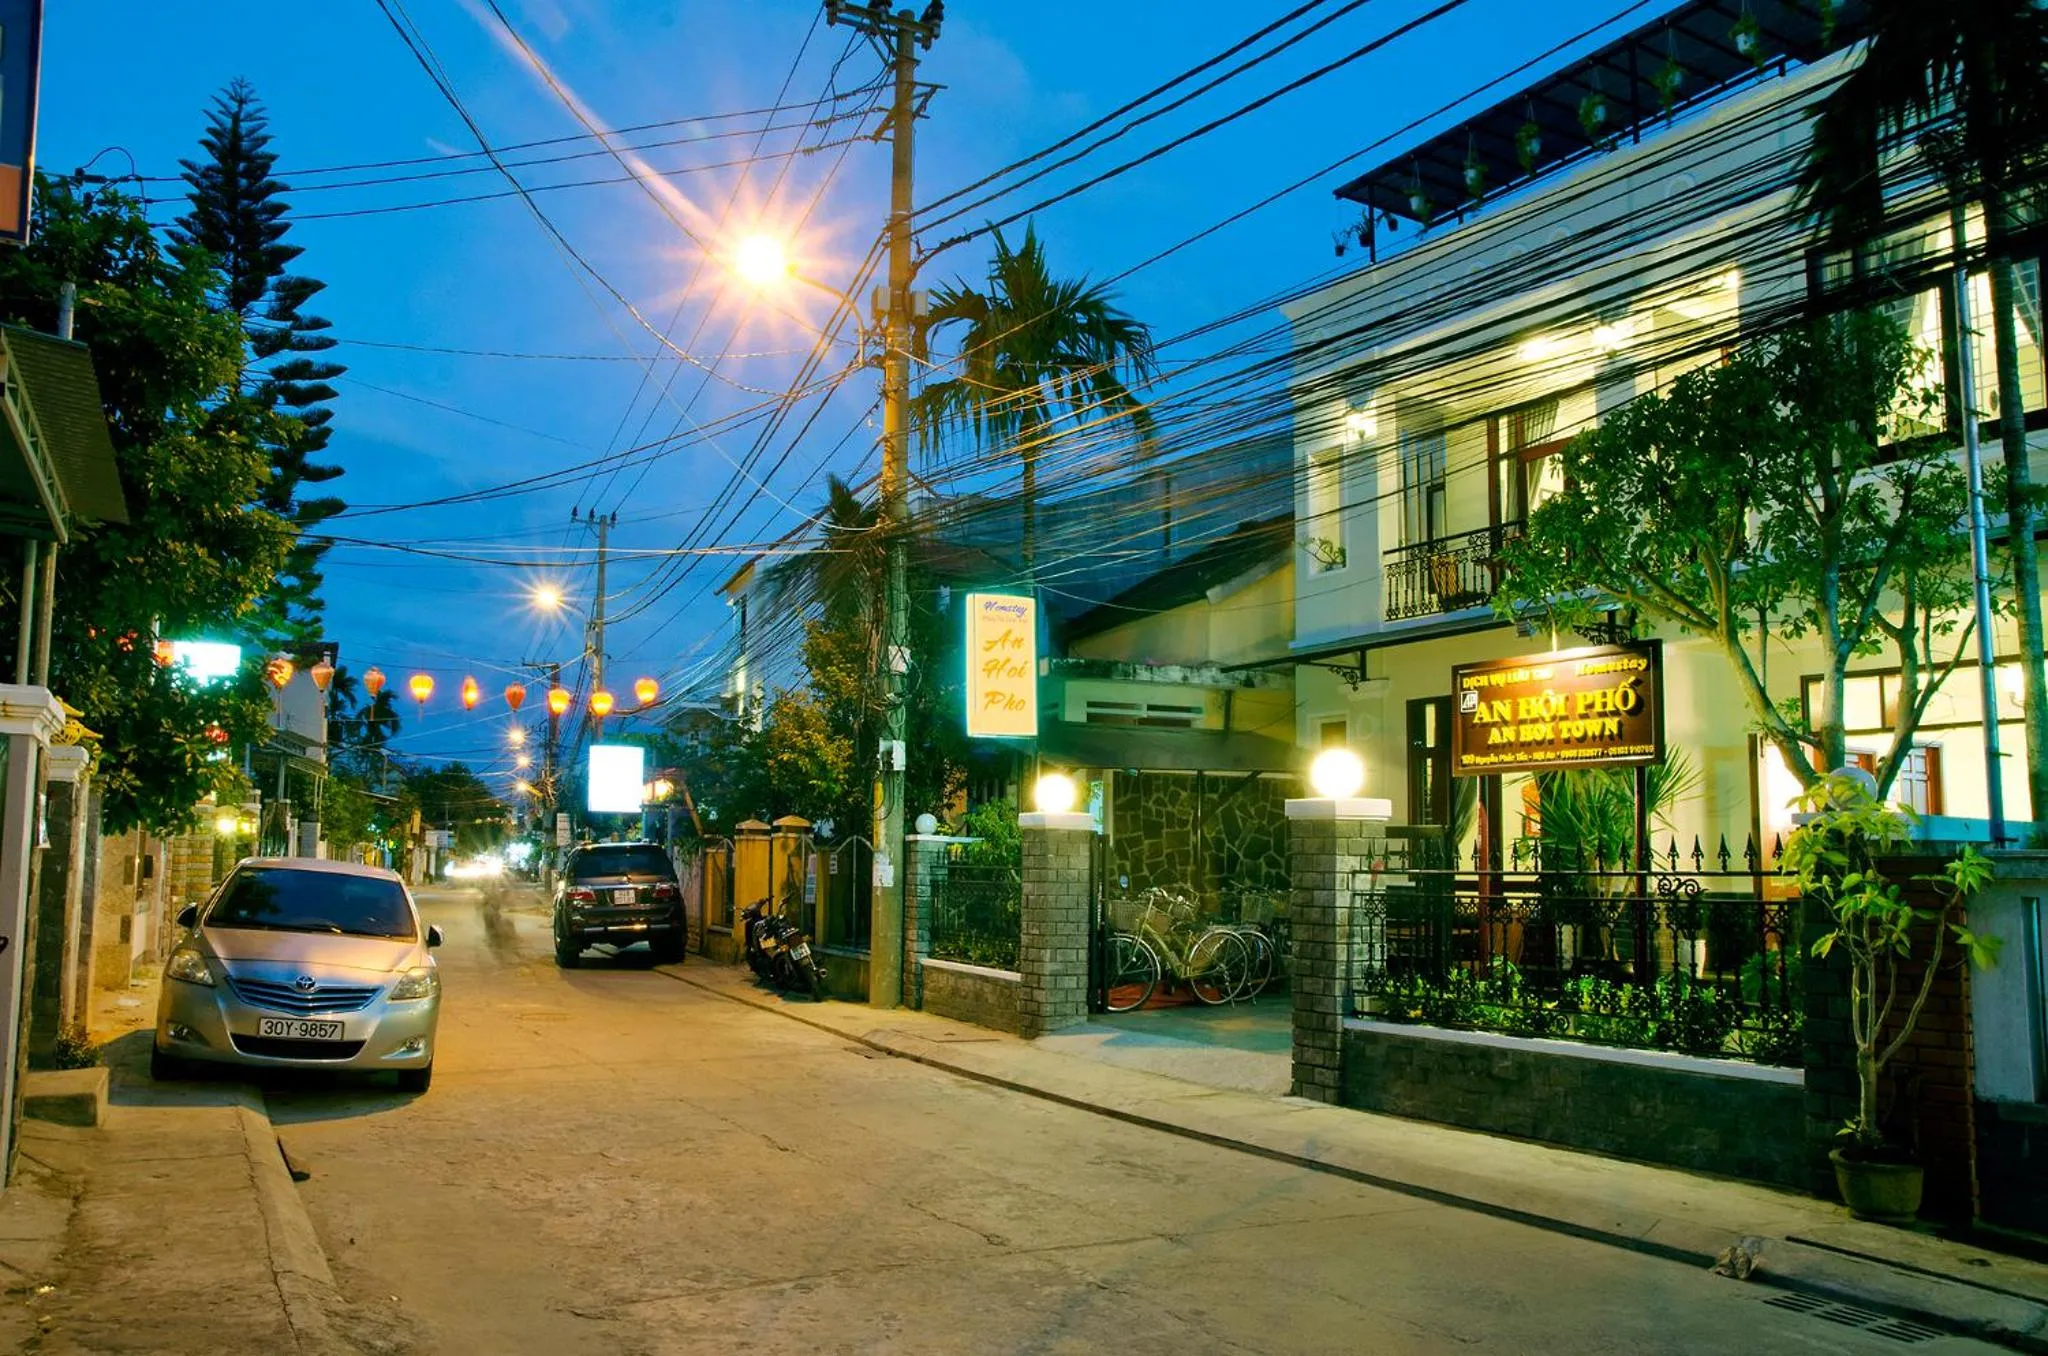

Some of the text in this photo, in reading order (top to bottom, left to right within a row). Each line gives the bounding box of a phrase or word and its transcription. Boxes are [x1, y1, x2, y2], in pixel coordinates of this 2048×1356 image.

[983, 628, 1025, 652] An
[982, 657, 1028, 679] Hoi
[1577, 656, 1648, 677] Homestay
[983, 690, 1026, 712] Pho
[1473, 676, 1638, 724] AN HỘI PHỐ
[1487, 726, 1518, 746] AN
[1560, 717, 1619, 740] TOWN
